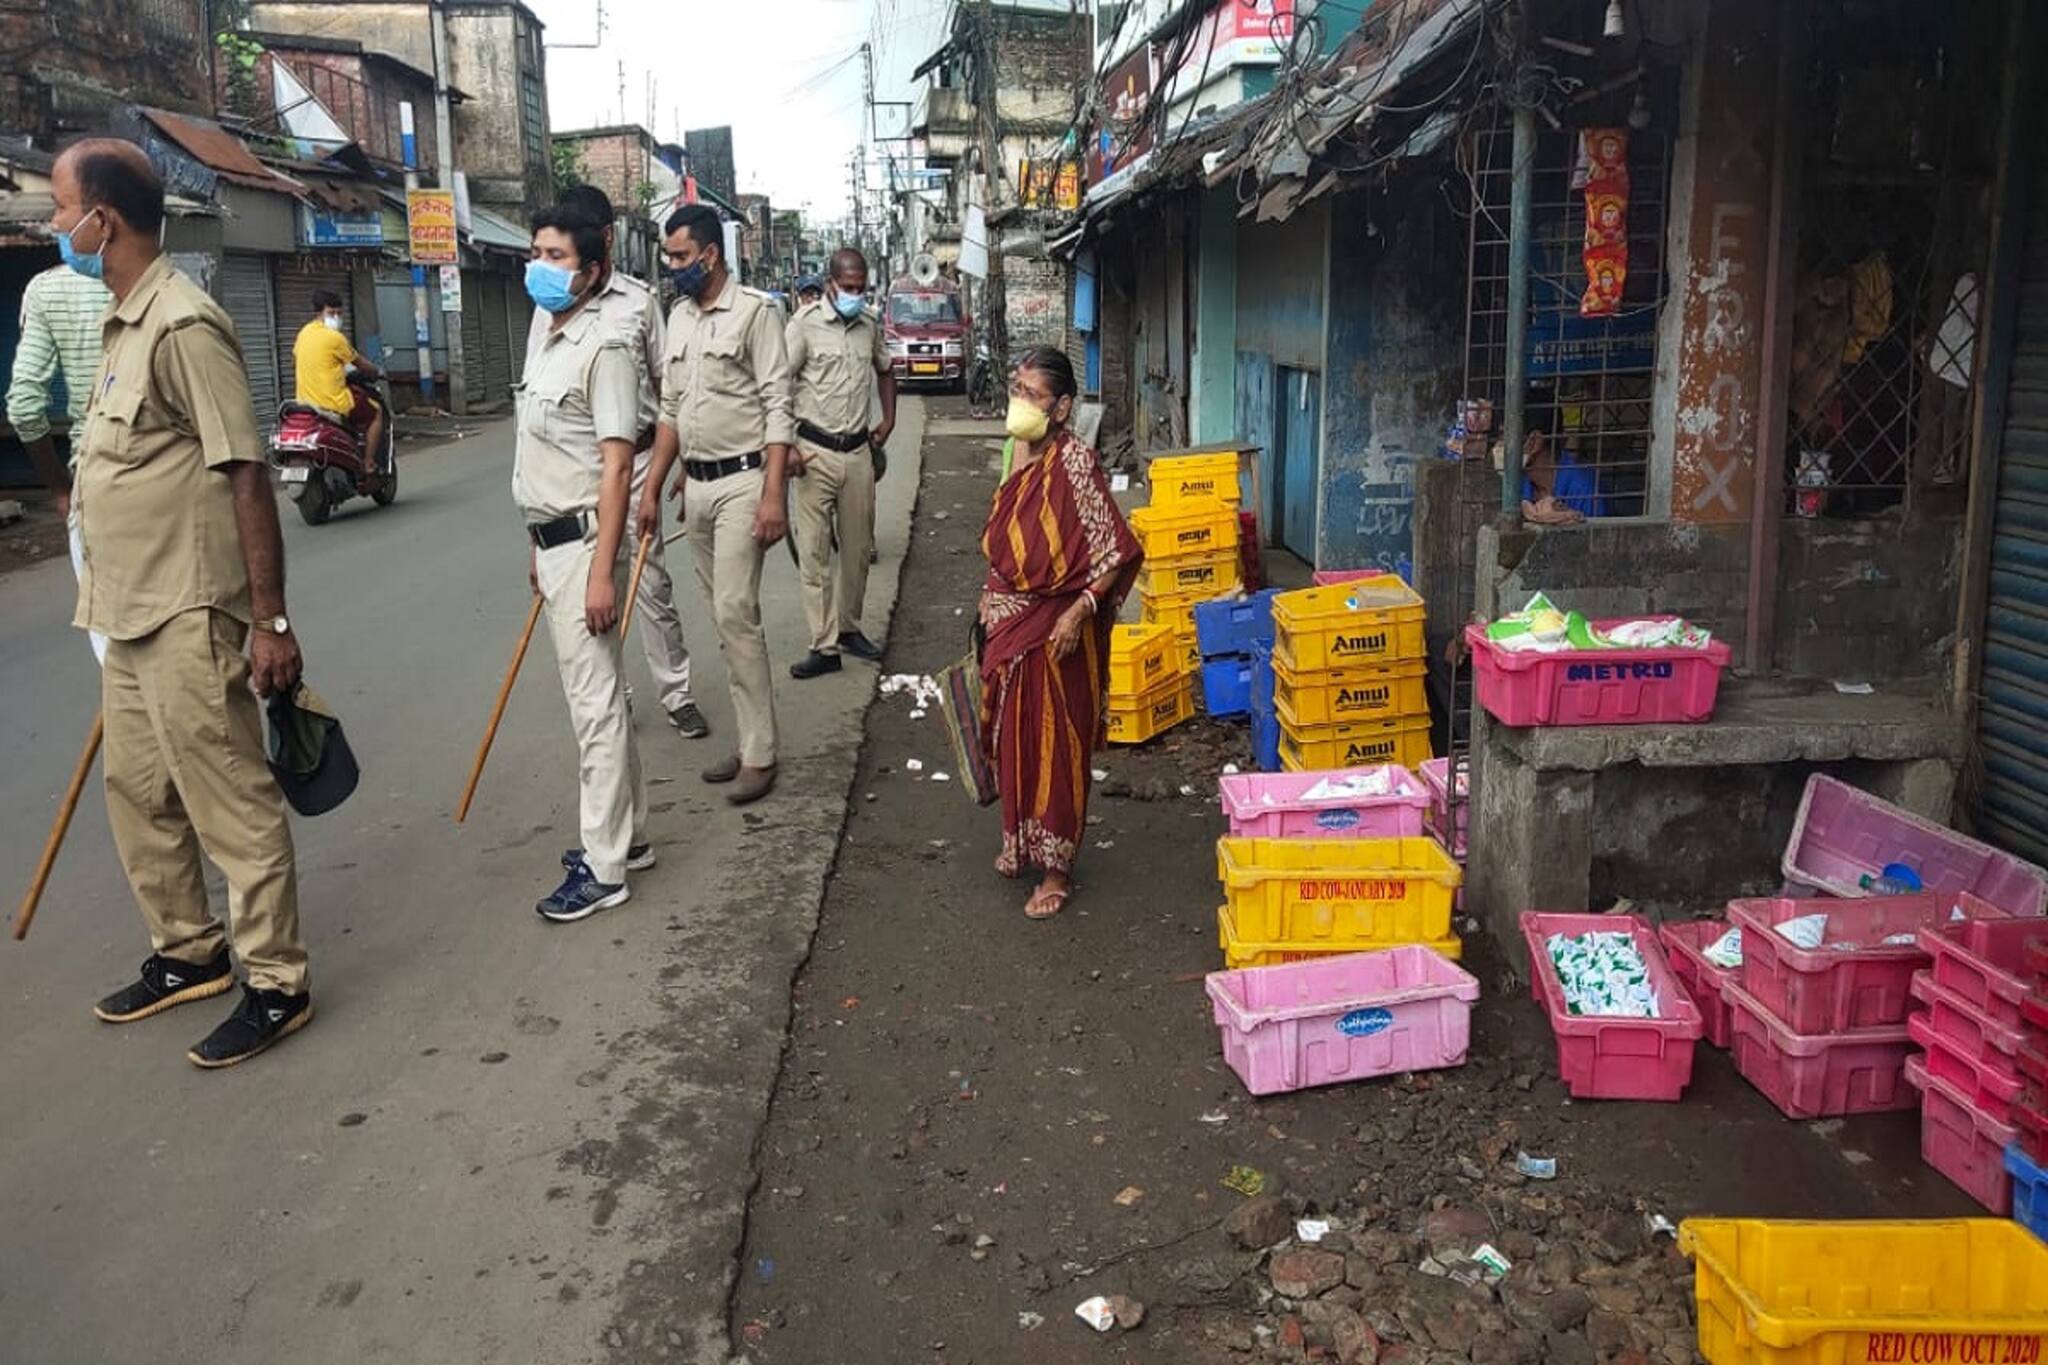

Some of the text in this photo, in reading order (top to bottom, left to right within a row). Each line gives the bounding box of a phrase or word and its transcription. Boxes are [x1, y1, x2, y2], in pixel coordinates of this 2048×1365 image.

[1181, 481, 1214, 493] Amul
[1331, 632, 1386, 653] Amul
[1567, 662, 1673, 681] METRO
[1335, 686, 1389, 705] Amul
[1344, 741, 1395, 761] Amul
[1301, 881, 1318, 900] RED
[1867, 1332, 2041, 1364] RED COW OCT 2020
